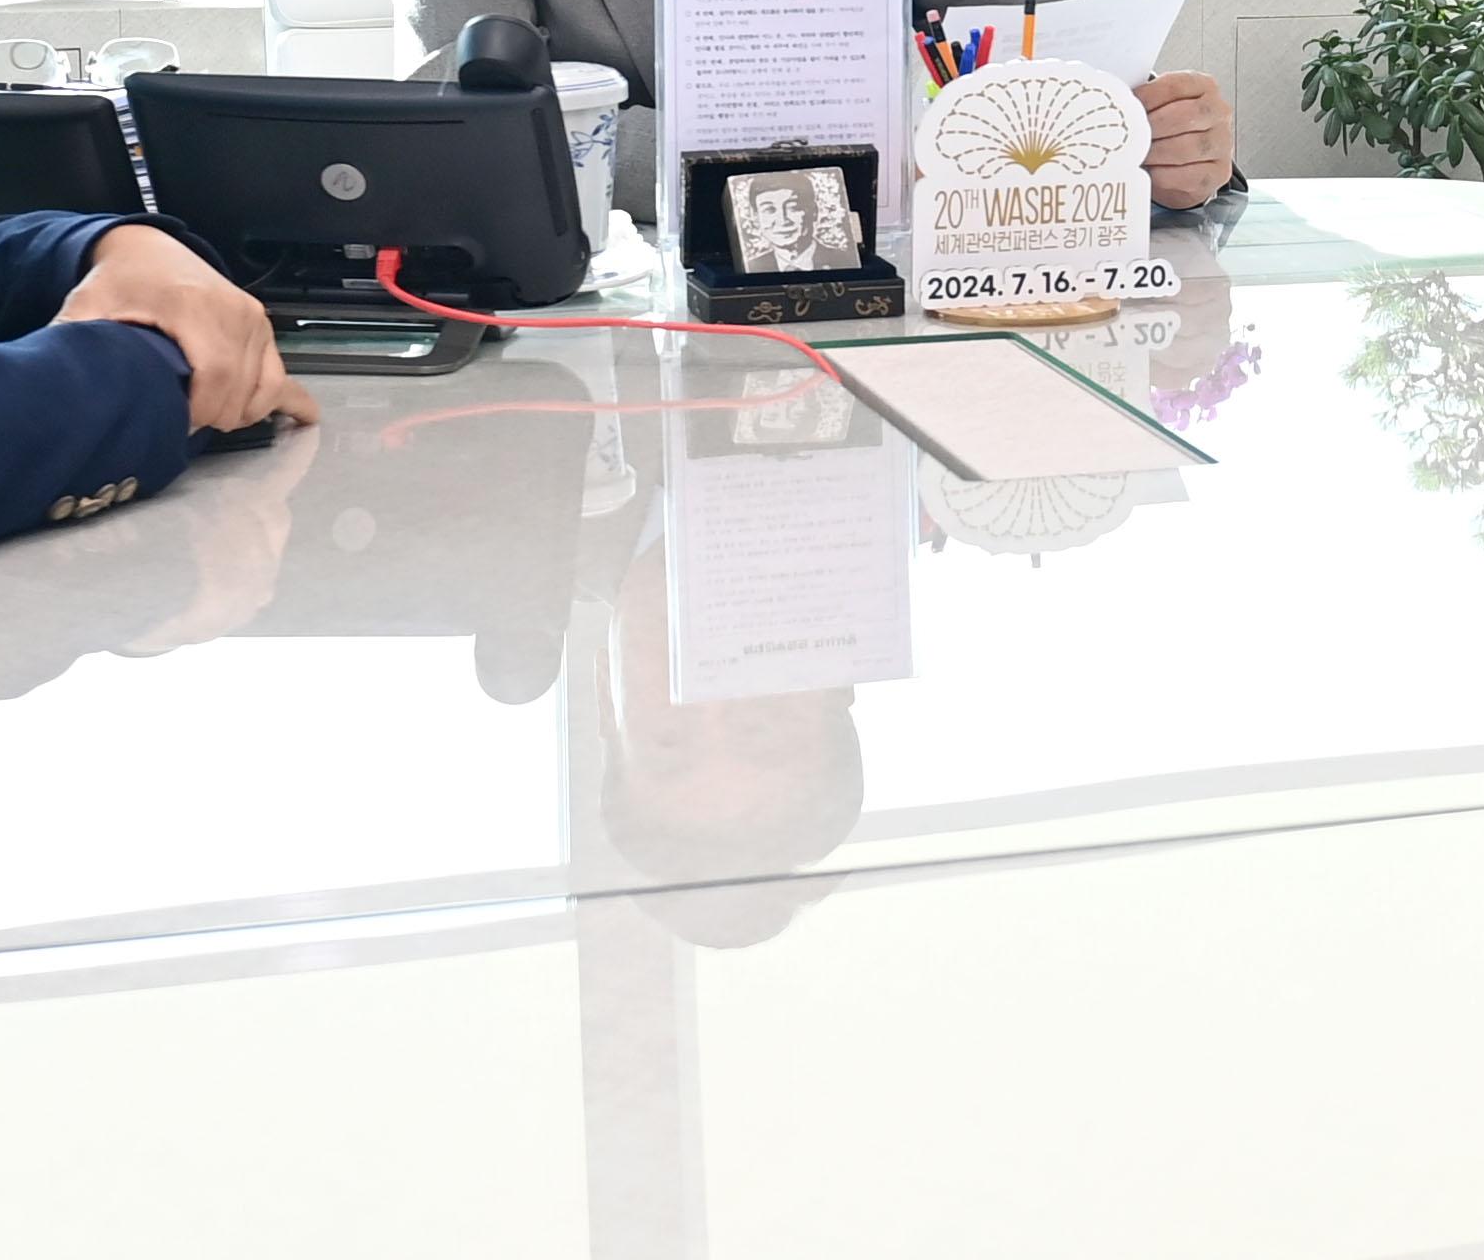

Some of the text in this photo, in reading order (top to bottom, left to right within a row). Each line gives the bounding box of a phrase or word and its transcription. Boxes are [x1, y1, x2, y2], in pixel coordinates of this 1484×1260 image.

[983, 185, 1067, 227] WASBE
[1072, 182, 1128, 223] 2024
[933, 225, 1129, 255] 세계관악컨퍼런스 경기 광주
[927, 274, 1003, 300] 2024.
[1012, 272, 1034, 295] 7.
[1042, 270, 1077, 293] 16.
[1104, 267, 1125, 290] 7.
[1133, 264, 1173, 289] 20.
